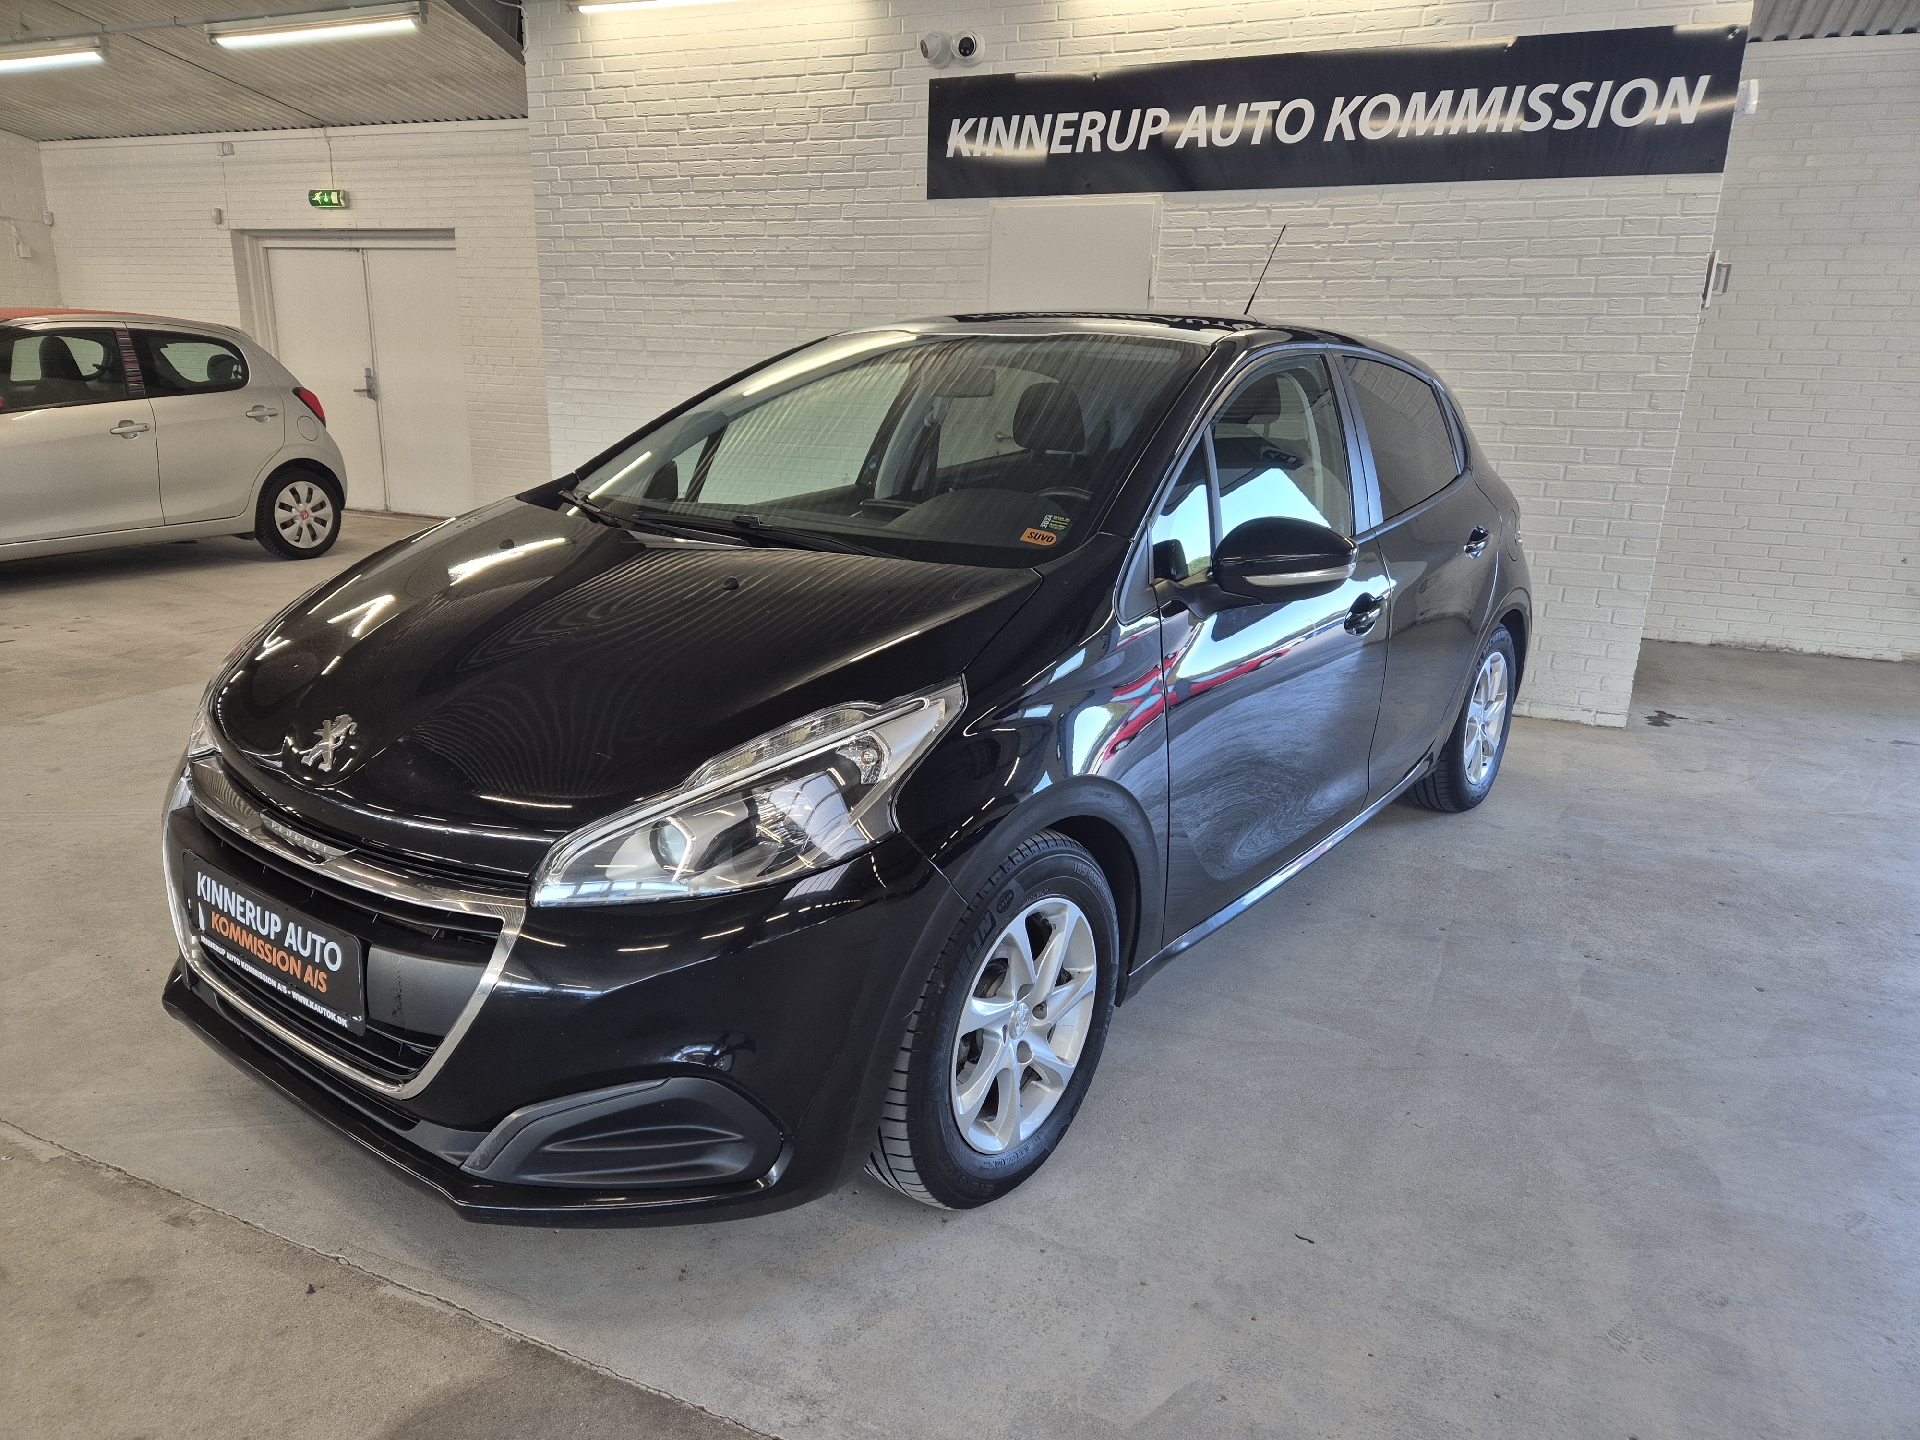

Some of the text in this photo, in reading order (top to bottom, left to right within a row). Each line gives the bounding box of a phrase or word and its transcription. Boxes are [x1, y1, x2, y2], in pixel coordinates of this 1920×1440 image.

[946, 75, 1711, 158] KINNERUP AUTO KOMMISSION
[1027, 531, 1054, 542] SUVO
[197, 871, 342, 972] KINNERUP AUTO
[211, 911, 302, 980] KOMMISSION
